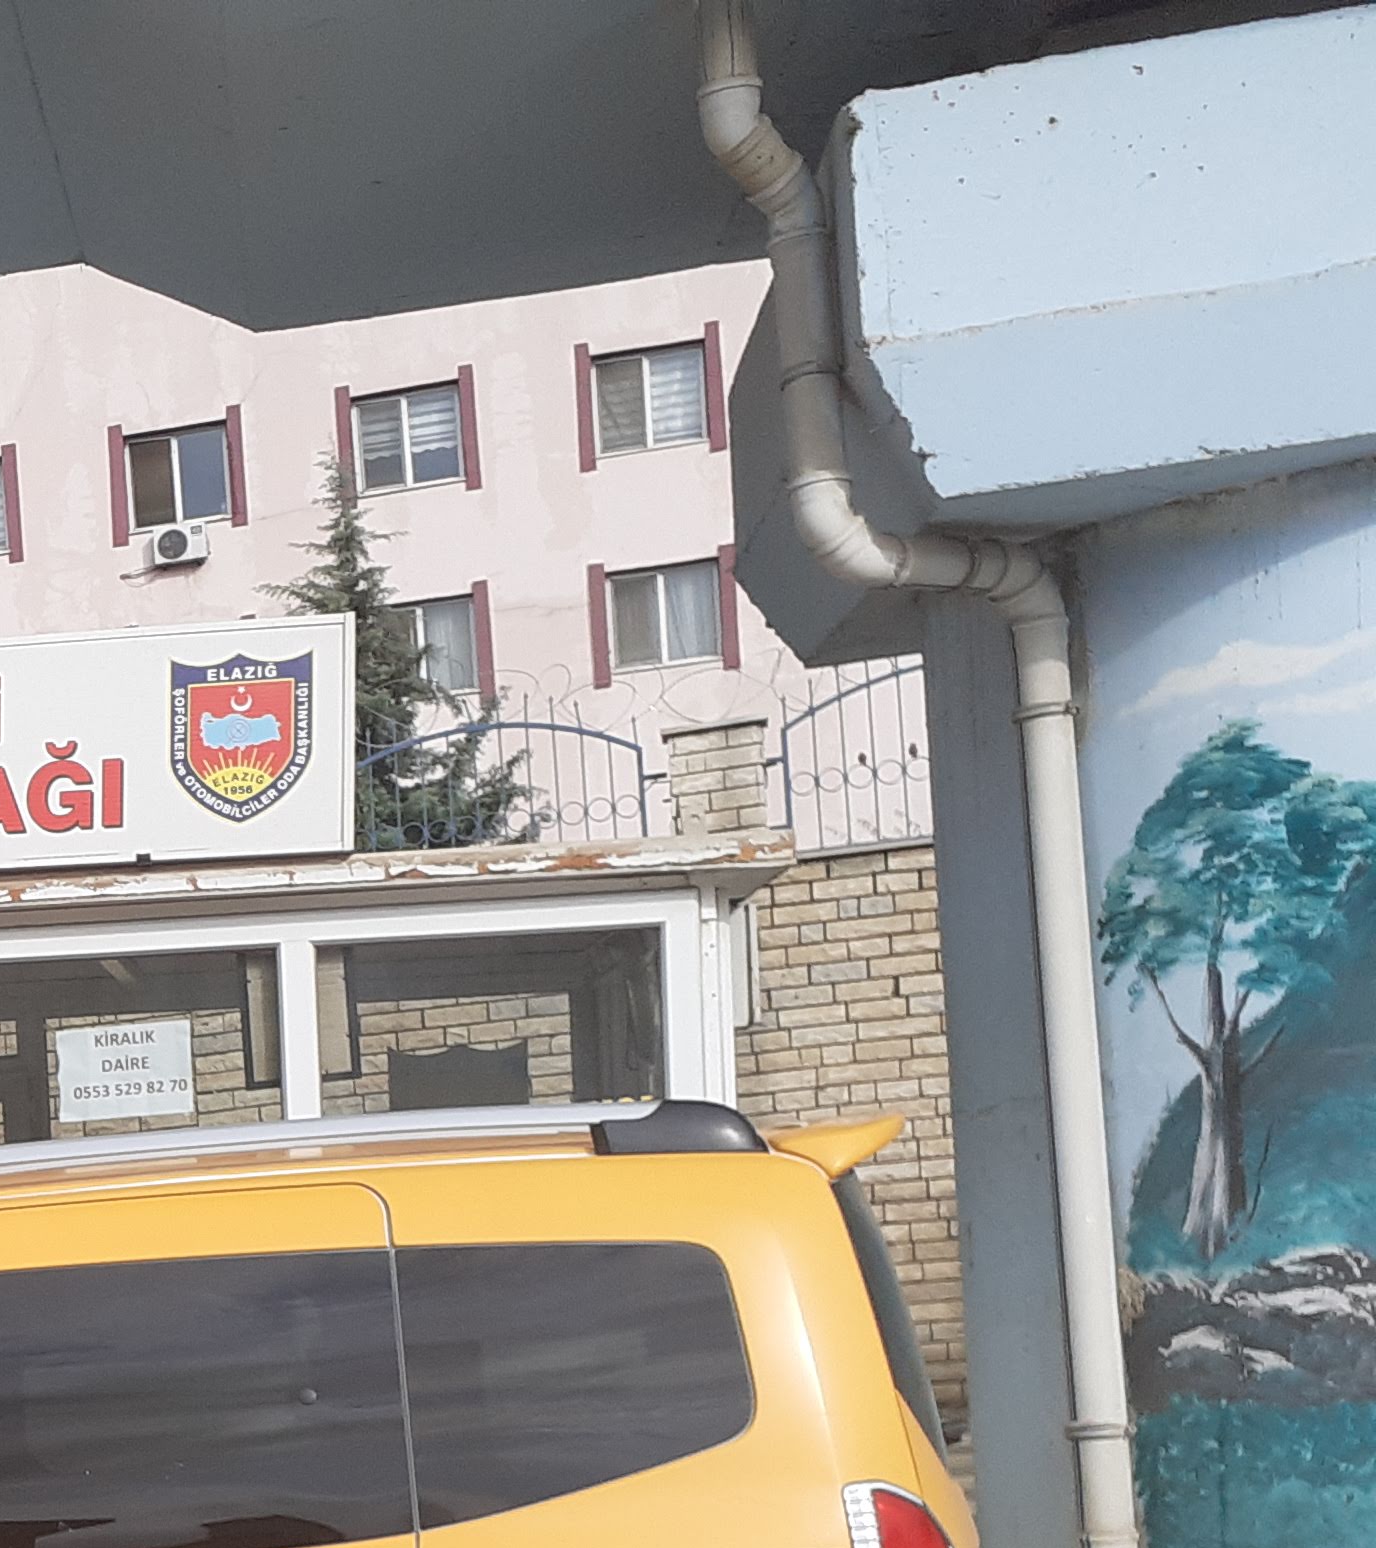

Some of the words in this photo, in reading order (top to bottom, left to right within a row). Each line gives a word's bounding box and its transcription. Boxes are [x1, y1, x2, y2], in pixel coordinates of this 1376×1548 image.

[207, 663, 277, 682] ELAZIĞ
[172, 688, 186, 759] ŞOFÖRLER
[176, 762, 186, 776] ve
[277, 766, 299, 790] ODA
[95, 1030, 156, 1047] KİRALIK
[102, 1055, 150, 1072] DAİRE
[74, 1085, 110, 1100] 0553
[115, 1082, 142, 1096] 529
[147, 1081, 164, 1094] 82
[170, 1079, 187, 1092] 70
